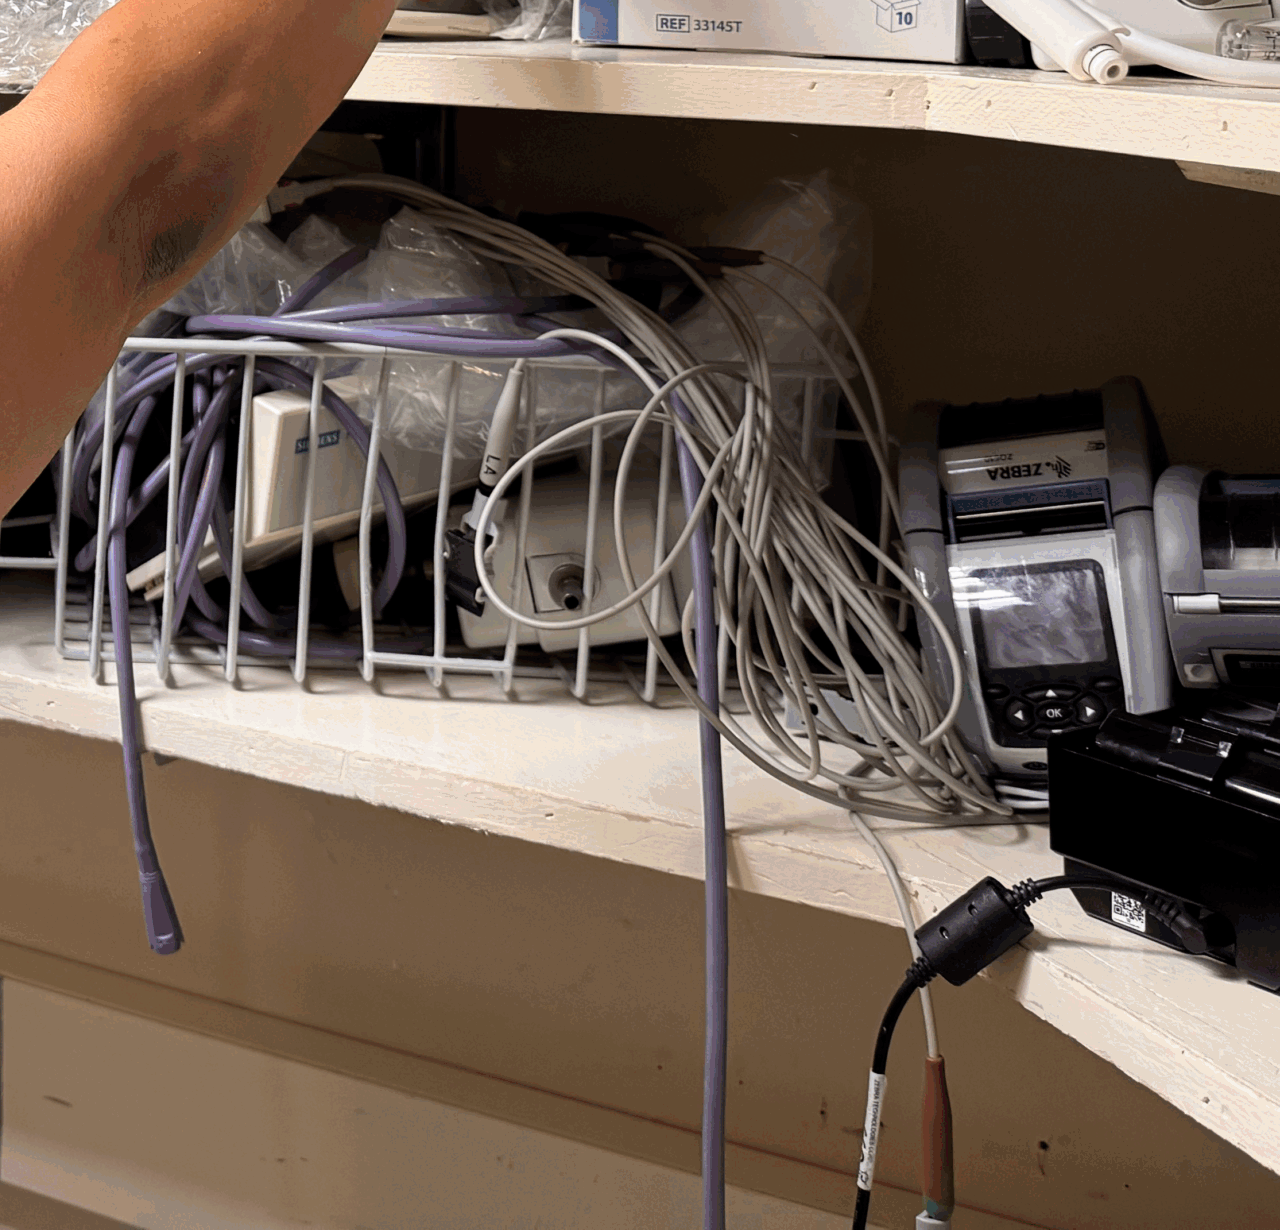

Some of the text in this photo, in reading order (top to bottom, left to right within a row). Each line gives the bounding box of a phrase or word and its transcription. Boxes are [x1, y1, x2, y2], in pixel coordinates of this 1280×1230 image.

[660, 18, 743, 33] REF 33145T
[895, 11, 914, 26] 10
[297, 433, 339, 451] SIENS
[483, 454, 501, 475] LA
[986, 462, 1043, 480] ZEBRA
[1045, 708, 1063, 719] OK
